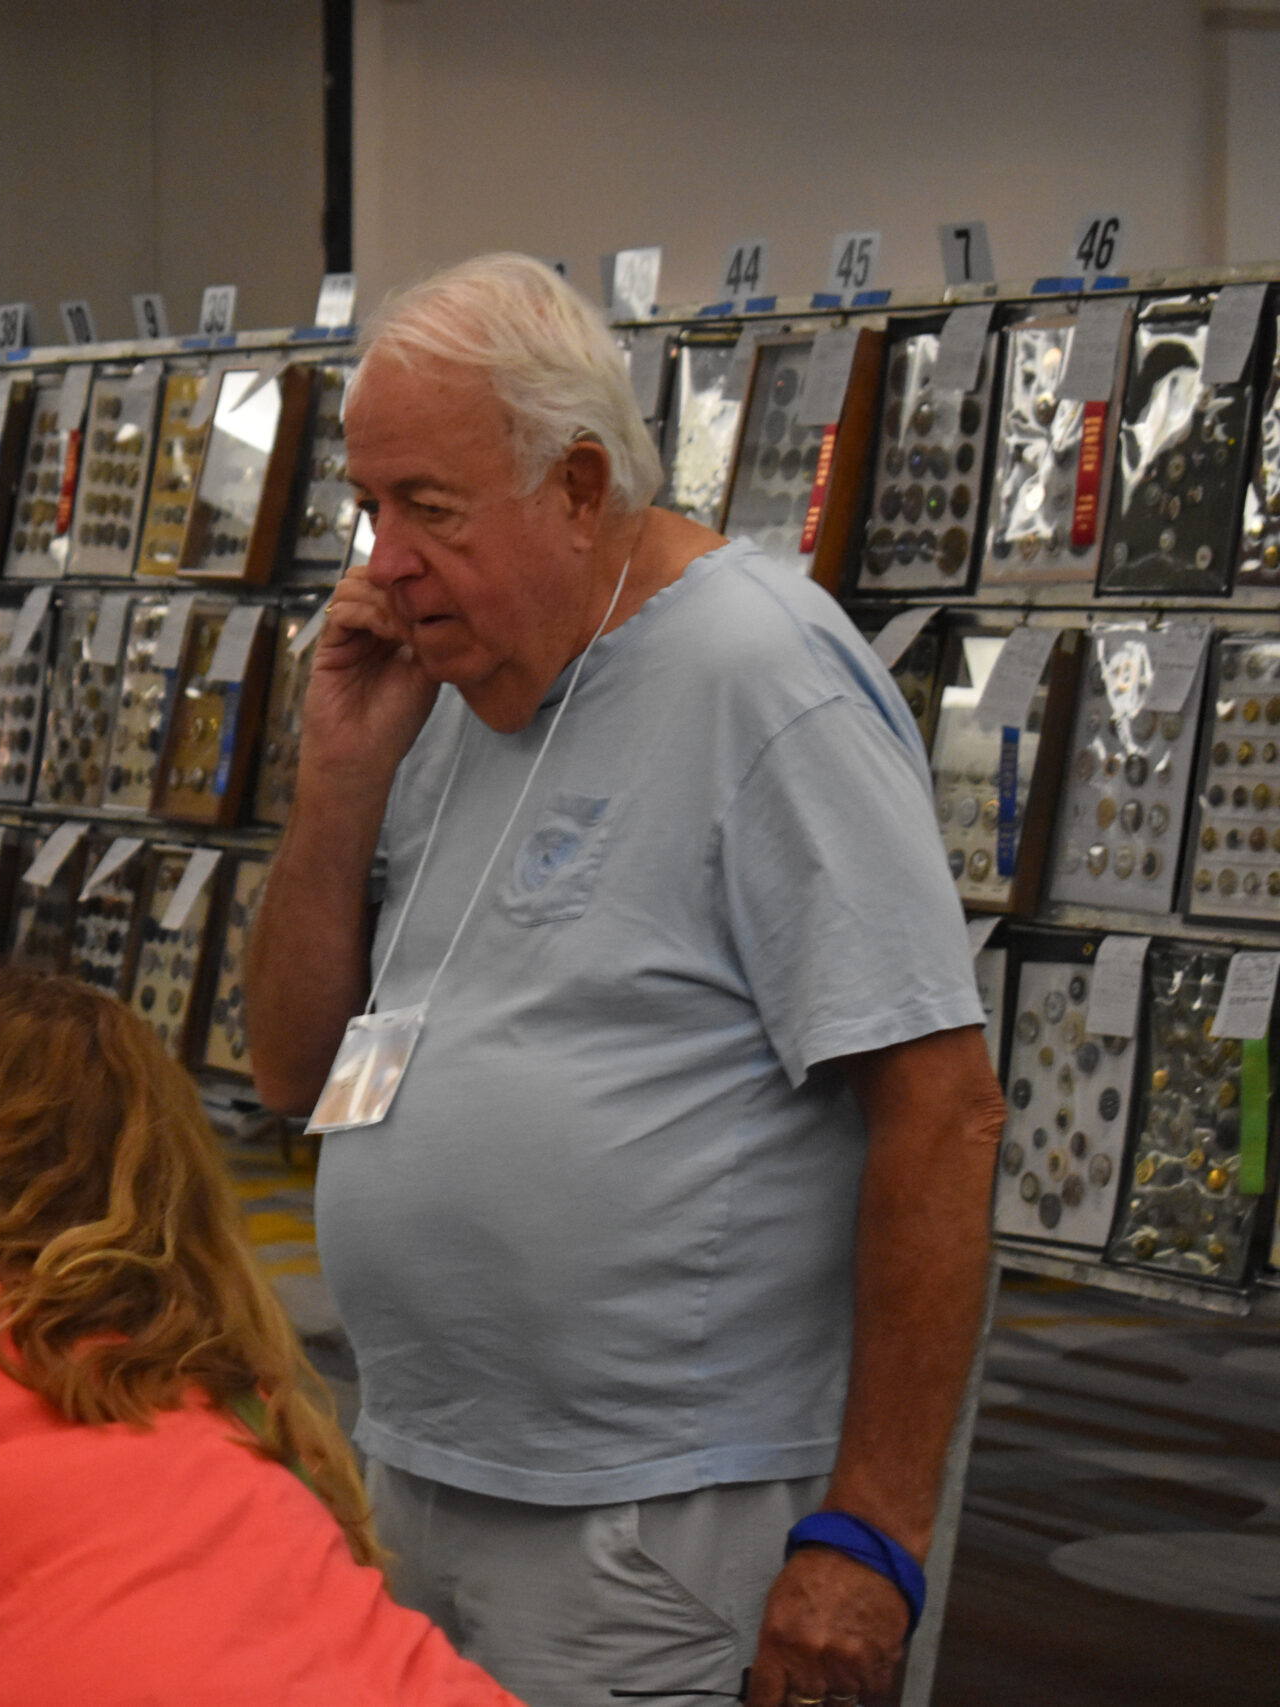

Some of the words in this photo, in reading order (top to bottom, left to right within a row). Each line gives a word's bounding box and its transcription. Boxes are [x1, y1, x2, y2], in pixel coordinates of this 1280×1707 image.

[835, 237, 874, 288] 45
[953, 227, 972, 280] 7
[1075, 216, 1122, 271] 46
[725, 244, 762, 294] 44
[67, 305, 92, 344] 10
[143, 298, 161, 339] 9
[204, 293, 230, 334] 39
